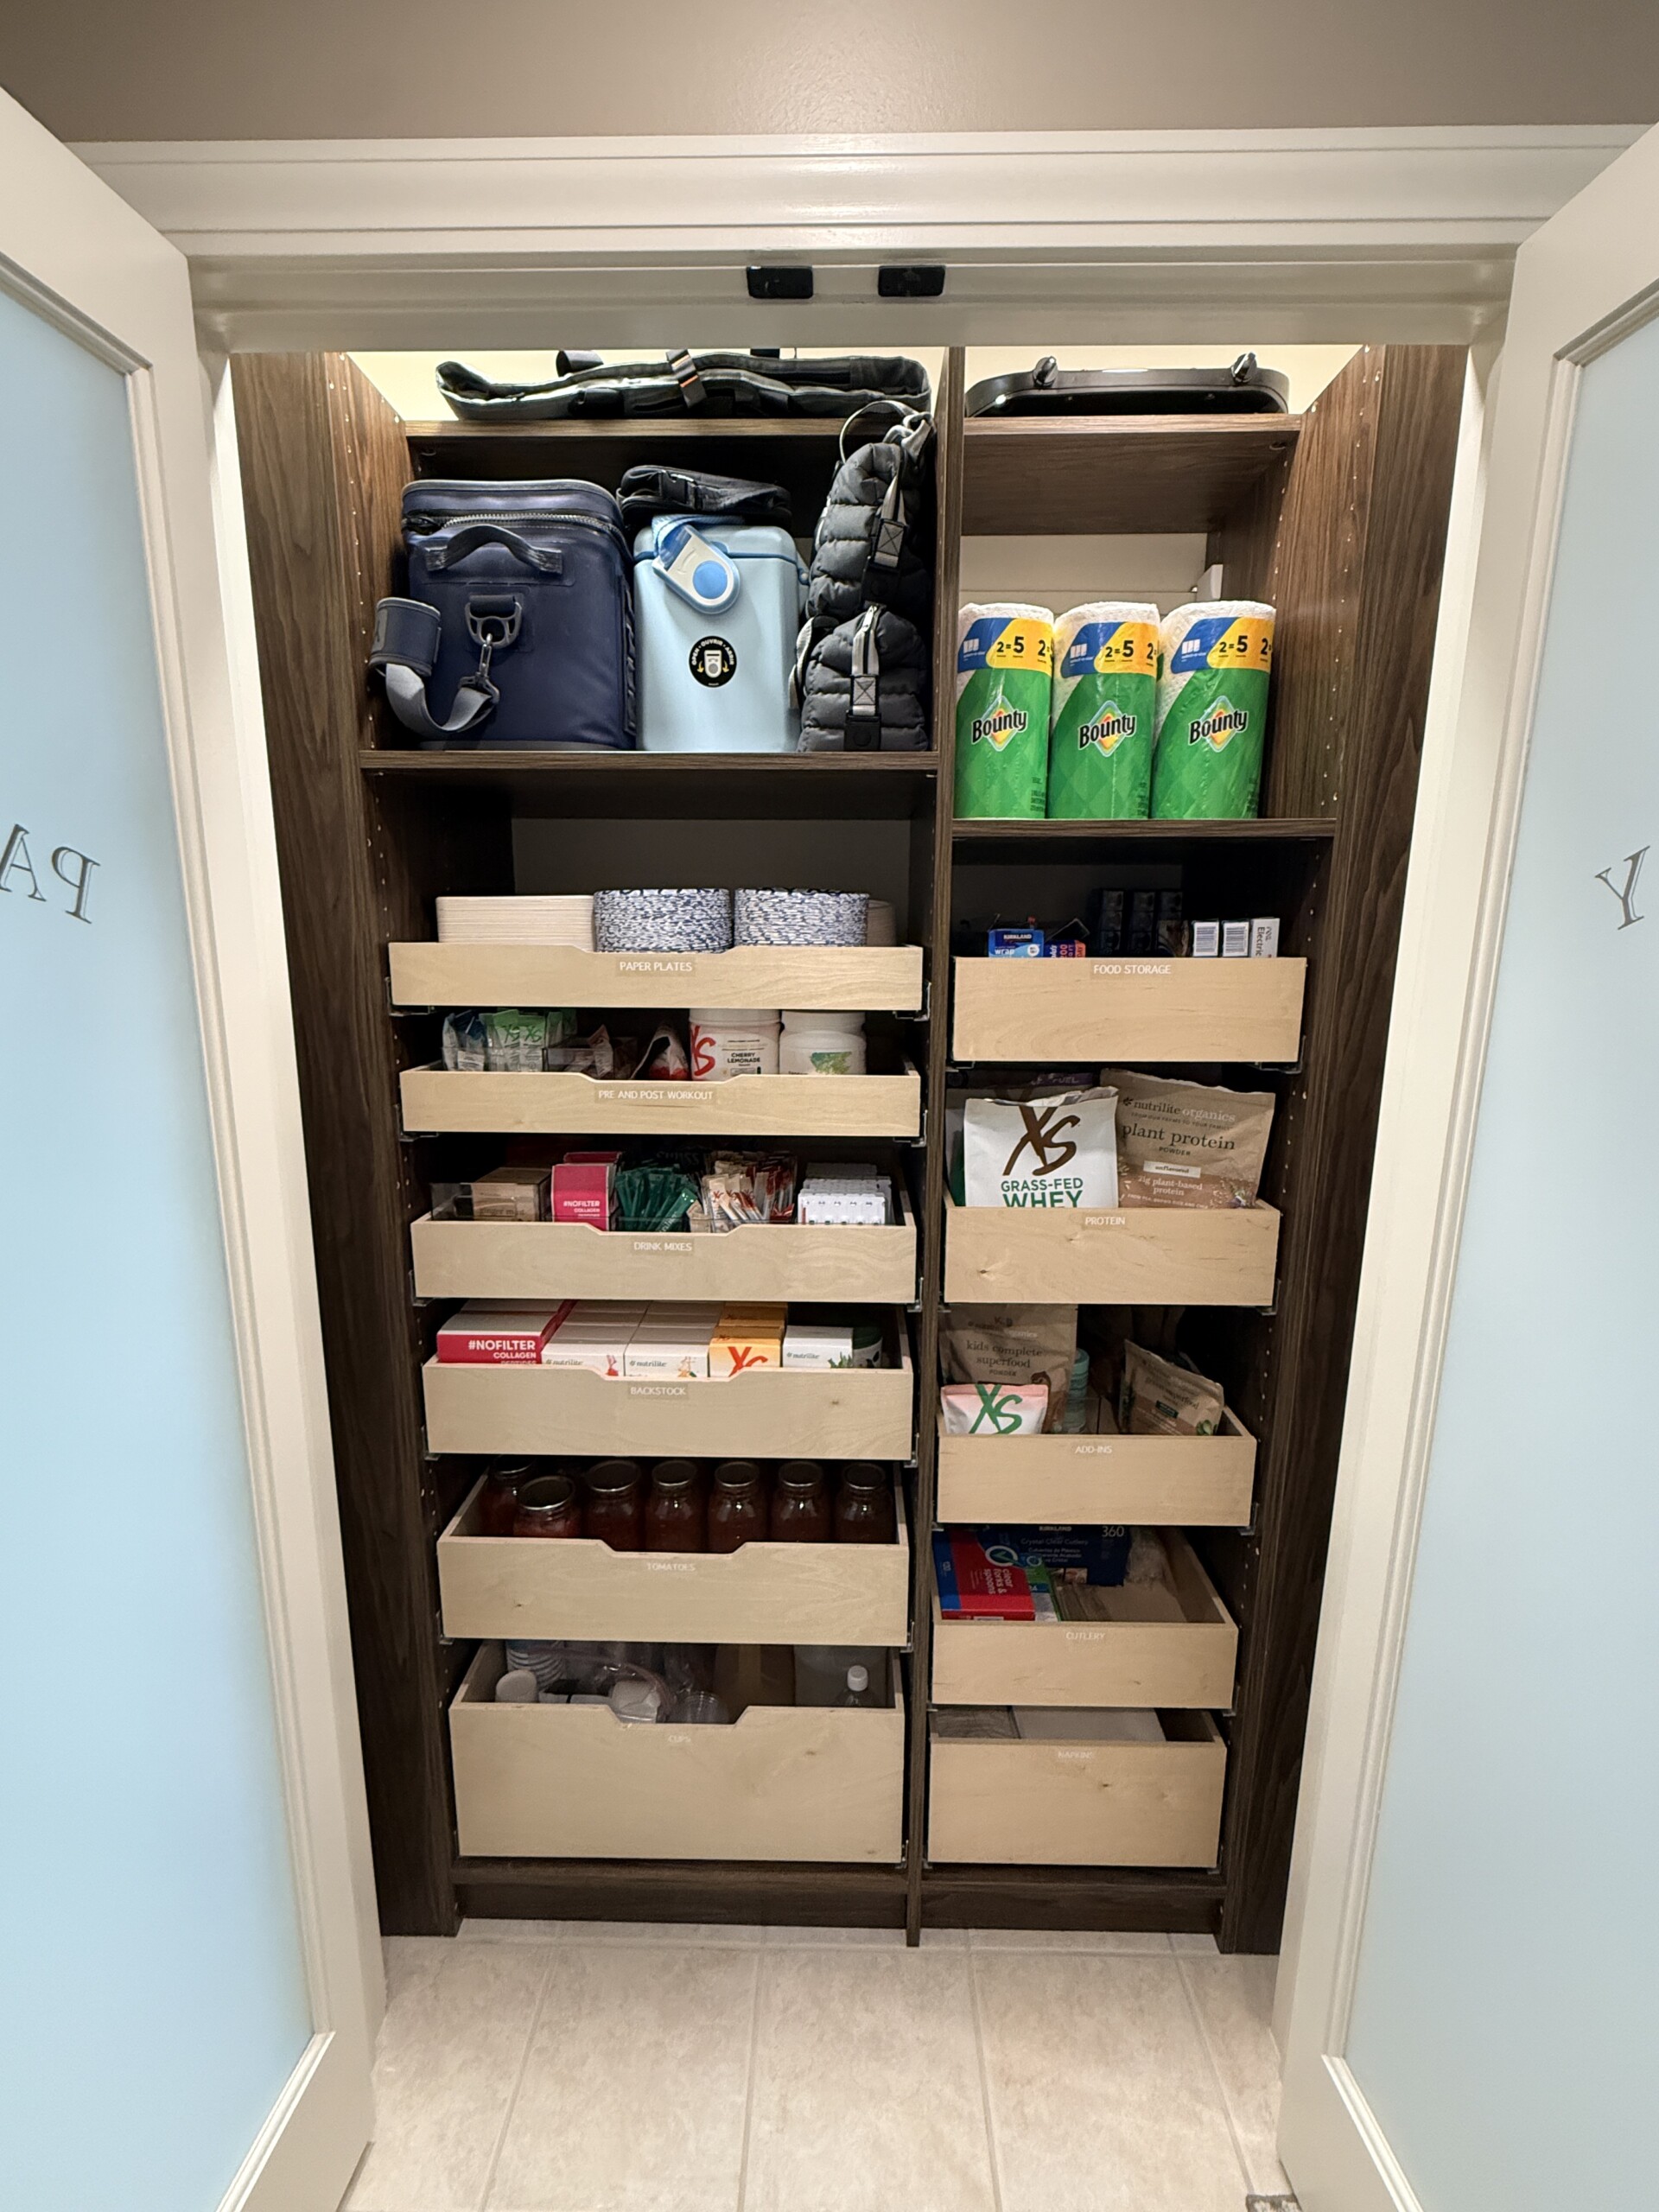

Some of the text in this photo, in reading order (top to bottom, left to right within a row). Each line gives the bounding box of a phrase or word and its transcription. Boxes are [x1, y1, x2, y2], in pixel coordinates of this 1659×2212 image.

[691, 647, 700, 665] OPEN
[972, 709, 1027, 744] Bounty
[1079, 711, 1137, 750] Bounty
[1189, 709, 1248, 745] Bounty
[620, 961, 693, 971] PAPER PLATES
[1093, 964, 1172, 975] FOOD STORAGE
[598, 1090, 714, 1100] PRE AND POST WORKOUT
[1134, 1100, 1237, 1123] nutrilite organics
[1002, 1106, 1081, 1176] XS
[1122, 1123, 1236, 1151] plant protein
[1159, 1146, 1191, 1156] POWDER
[1001, 1178, 1084, 1192] GRASS-FED
[1152, 1177, 1204, 1191] plant-based
[1153, 1186, 1185, 1197] protein
[1002, 1190, 1083, 1208] WHEY
[1084, 1216, 1126, 1225] PROTEIN
[634, 1242, 692, 1252] DRINK MIXES
[468, 1340, 536, 1351] #NOFILTER
[966, 1340, 1043, 1357] kids complete
[976, 1357, 1031, 1369] superfood
[630, 1386, 687, 1395] BACKSTOCK
[969, 1383, 1023, 1434] XS
[1075, 1446, 1113, 1454] ADD-INS
[1101, 1525, 1125, 1537] 360
[646, 1561, 696, 1571] TOMATOES
[983, 1568, 996, 1595] spoons
[994, 1568, 1004, 1587] forks
[1002, 1568, 1014, 1588] clear
[1065, 1630, 1106, 1640] CUTLERY
